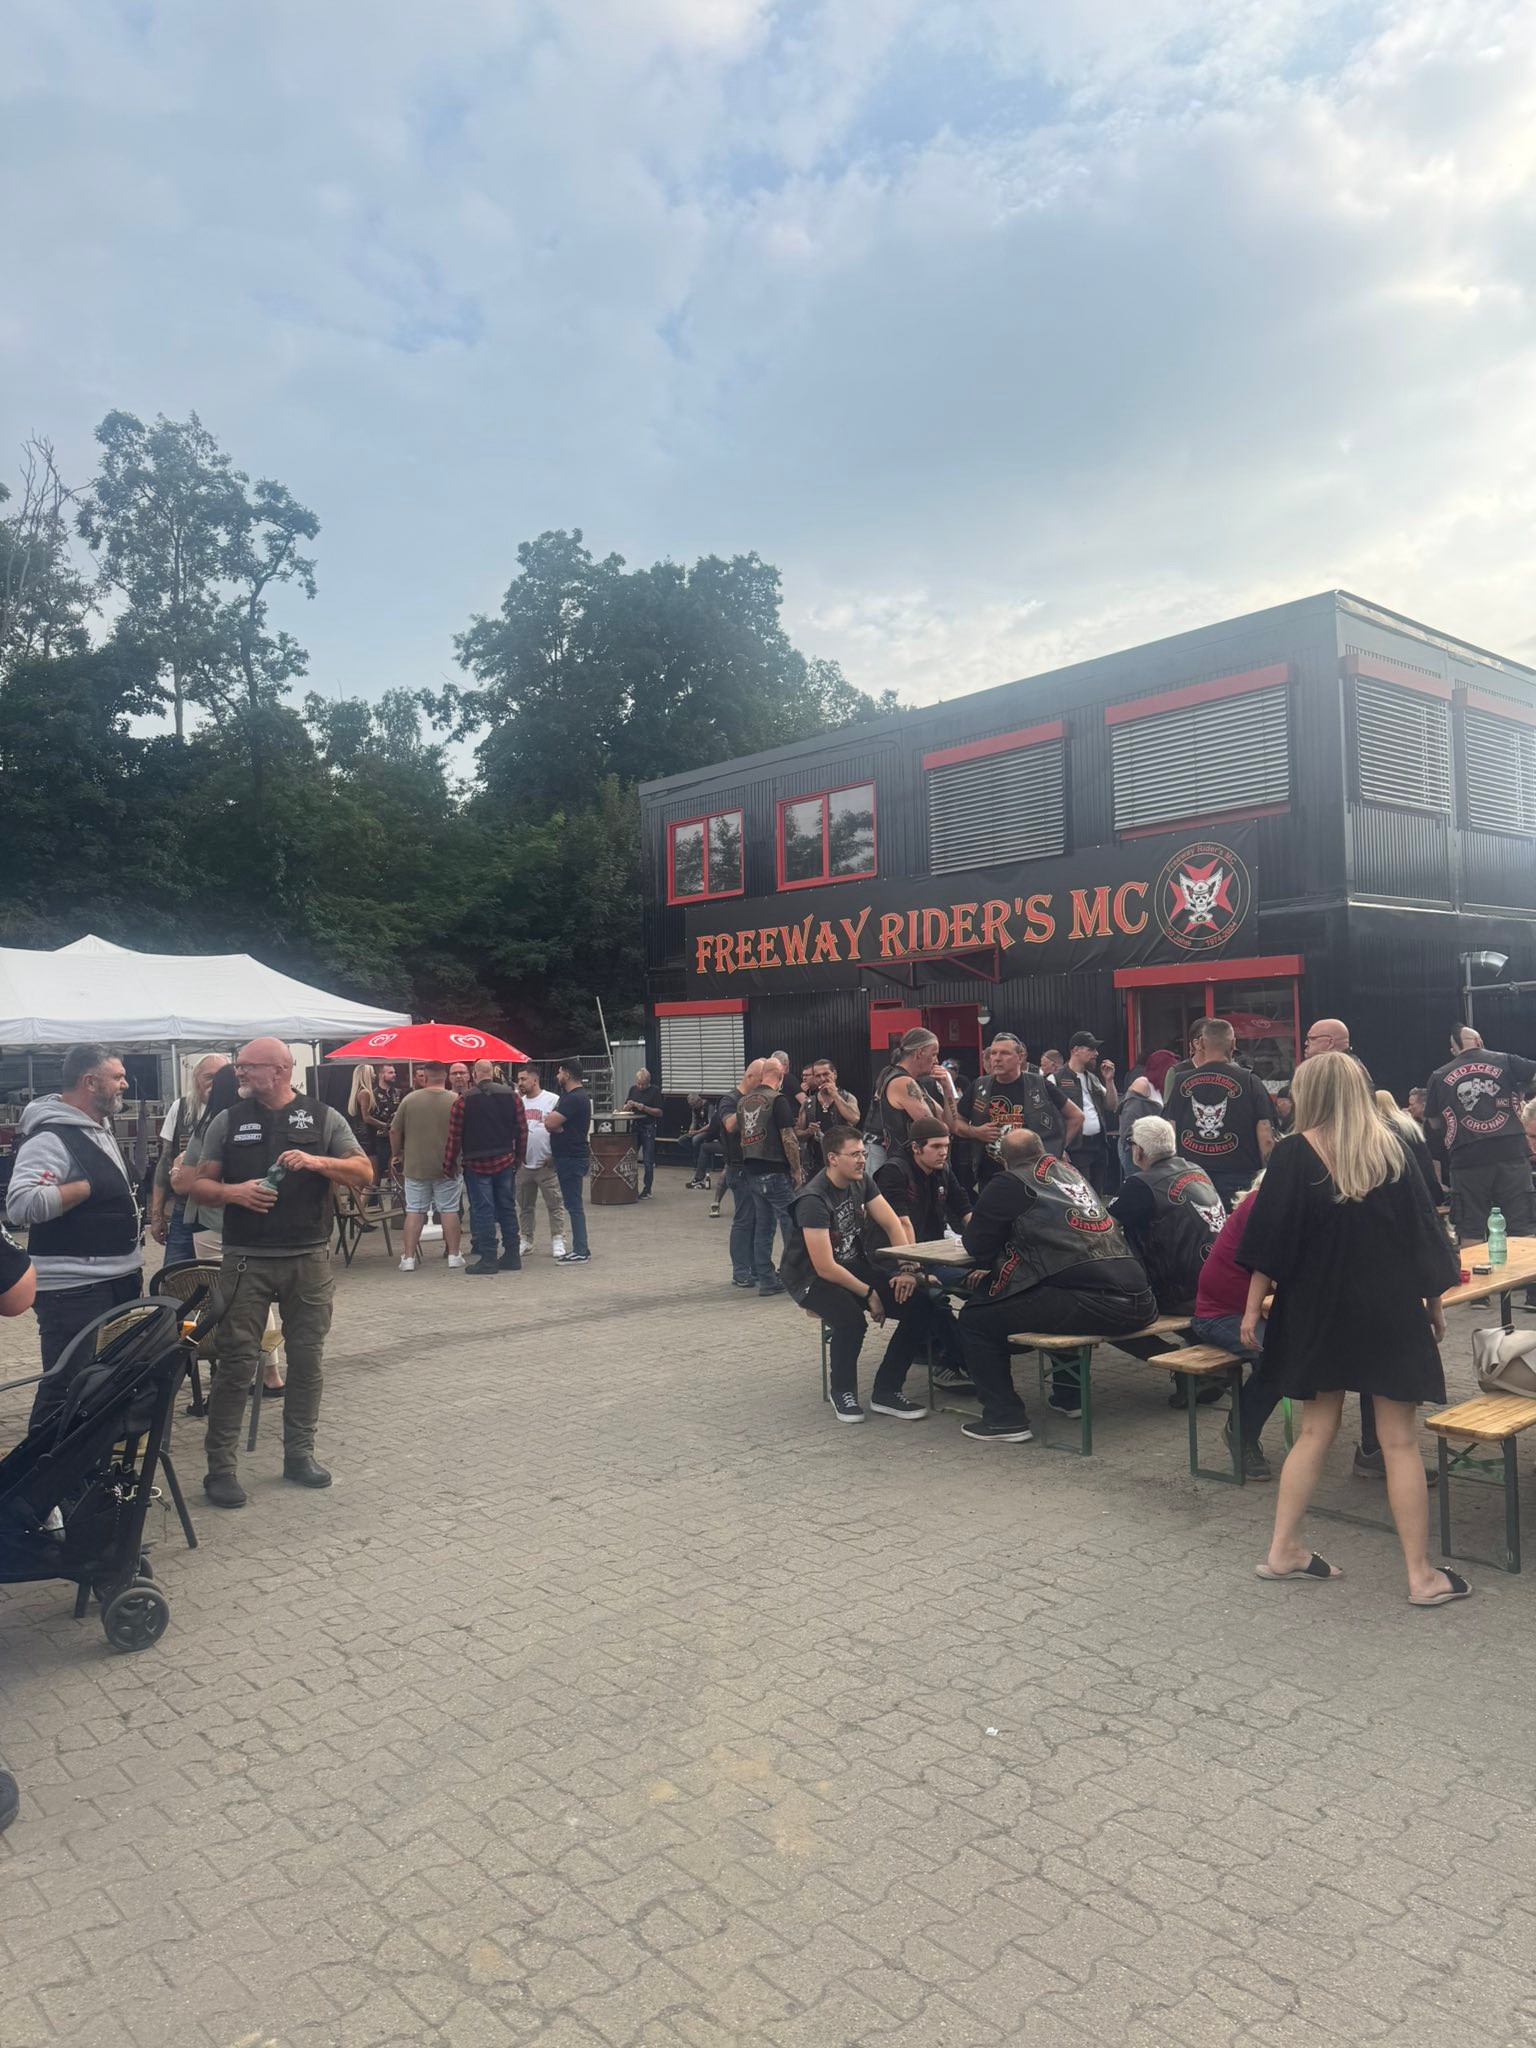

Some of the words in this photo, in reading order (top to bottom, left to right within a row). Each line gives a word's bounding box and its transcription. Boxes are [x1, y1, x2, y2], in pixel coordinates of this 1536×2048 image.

[1166, 847, 1195, 873] Freeway
[1197, 844, 1224, 856] Rider's
[1225, 851, 1237, 864] MC
[695, 905, 872, 975] FREEWAY
[879, 894, 1056, 957] RIDER'S
[1068, 881, 1150, 940] MC
[1446, 1066, 1468, 1084] RED
[1469, 1063, 1500, 1078] ACES
[1465, 1113, 1507, 1131] GRONAU
[1183, 1137, 1236, 1153] Dinslaken
